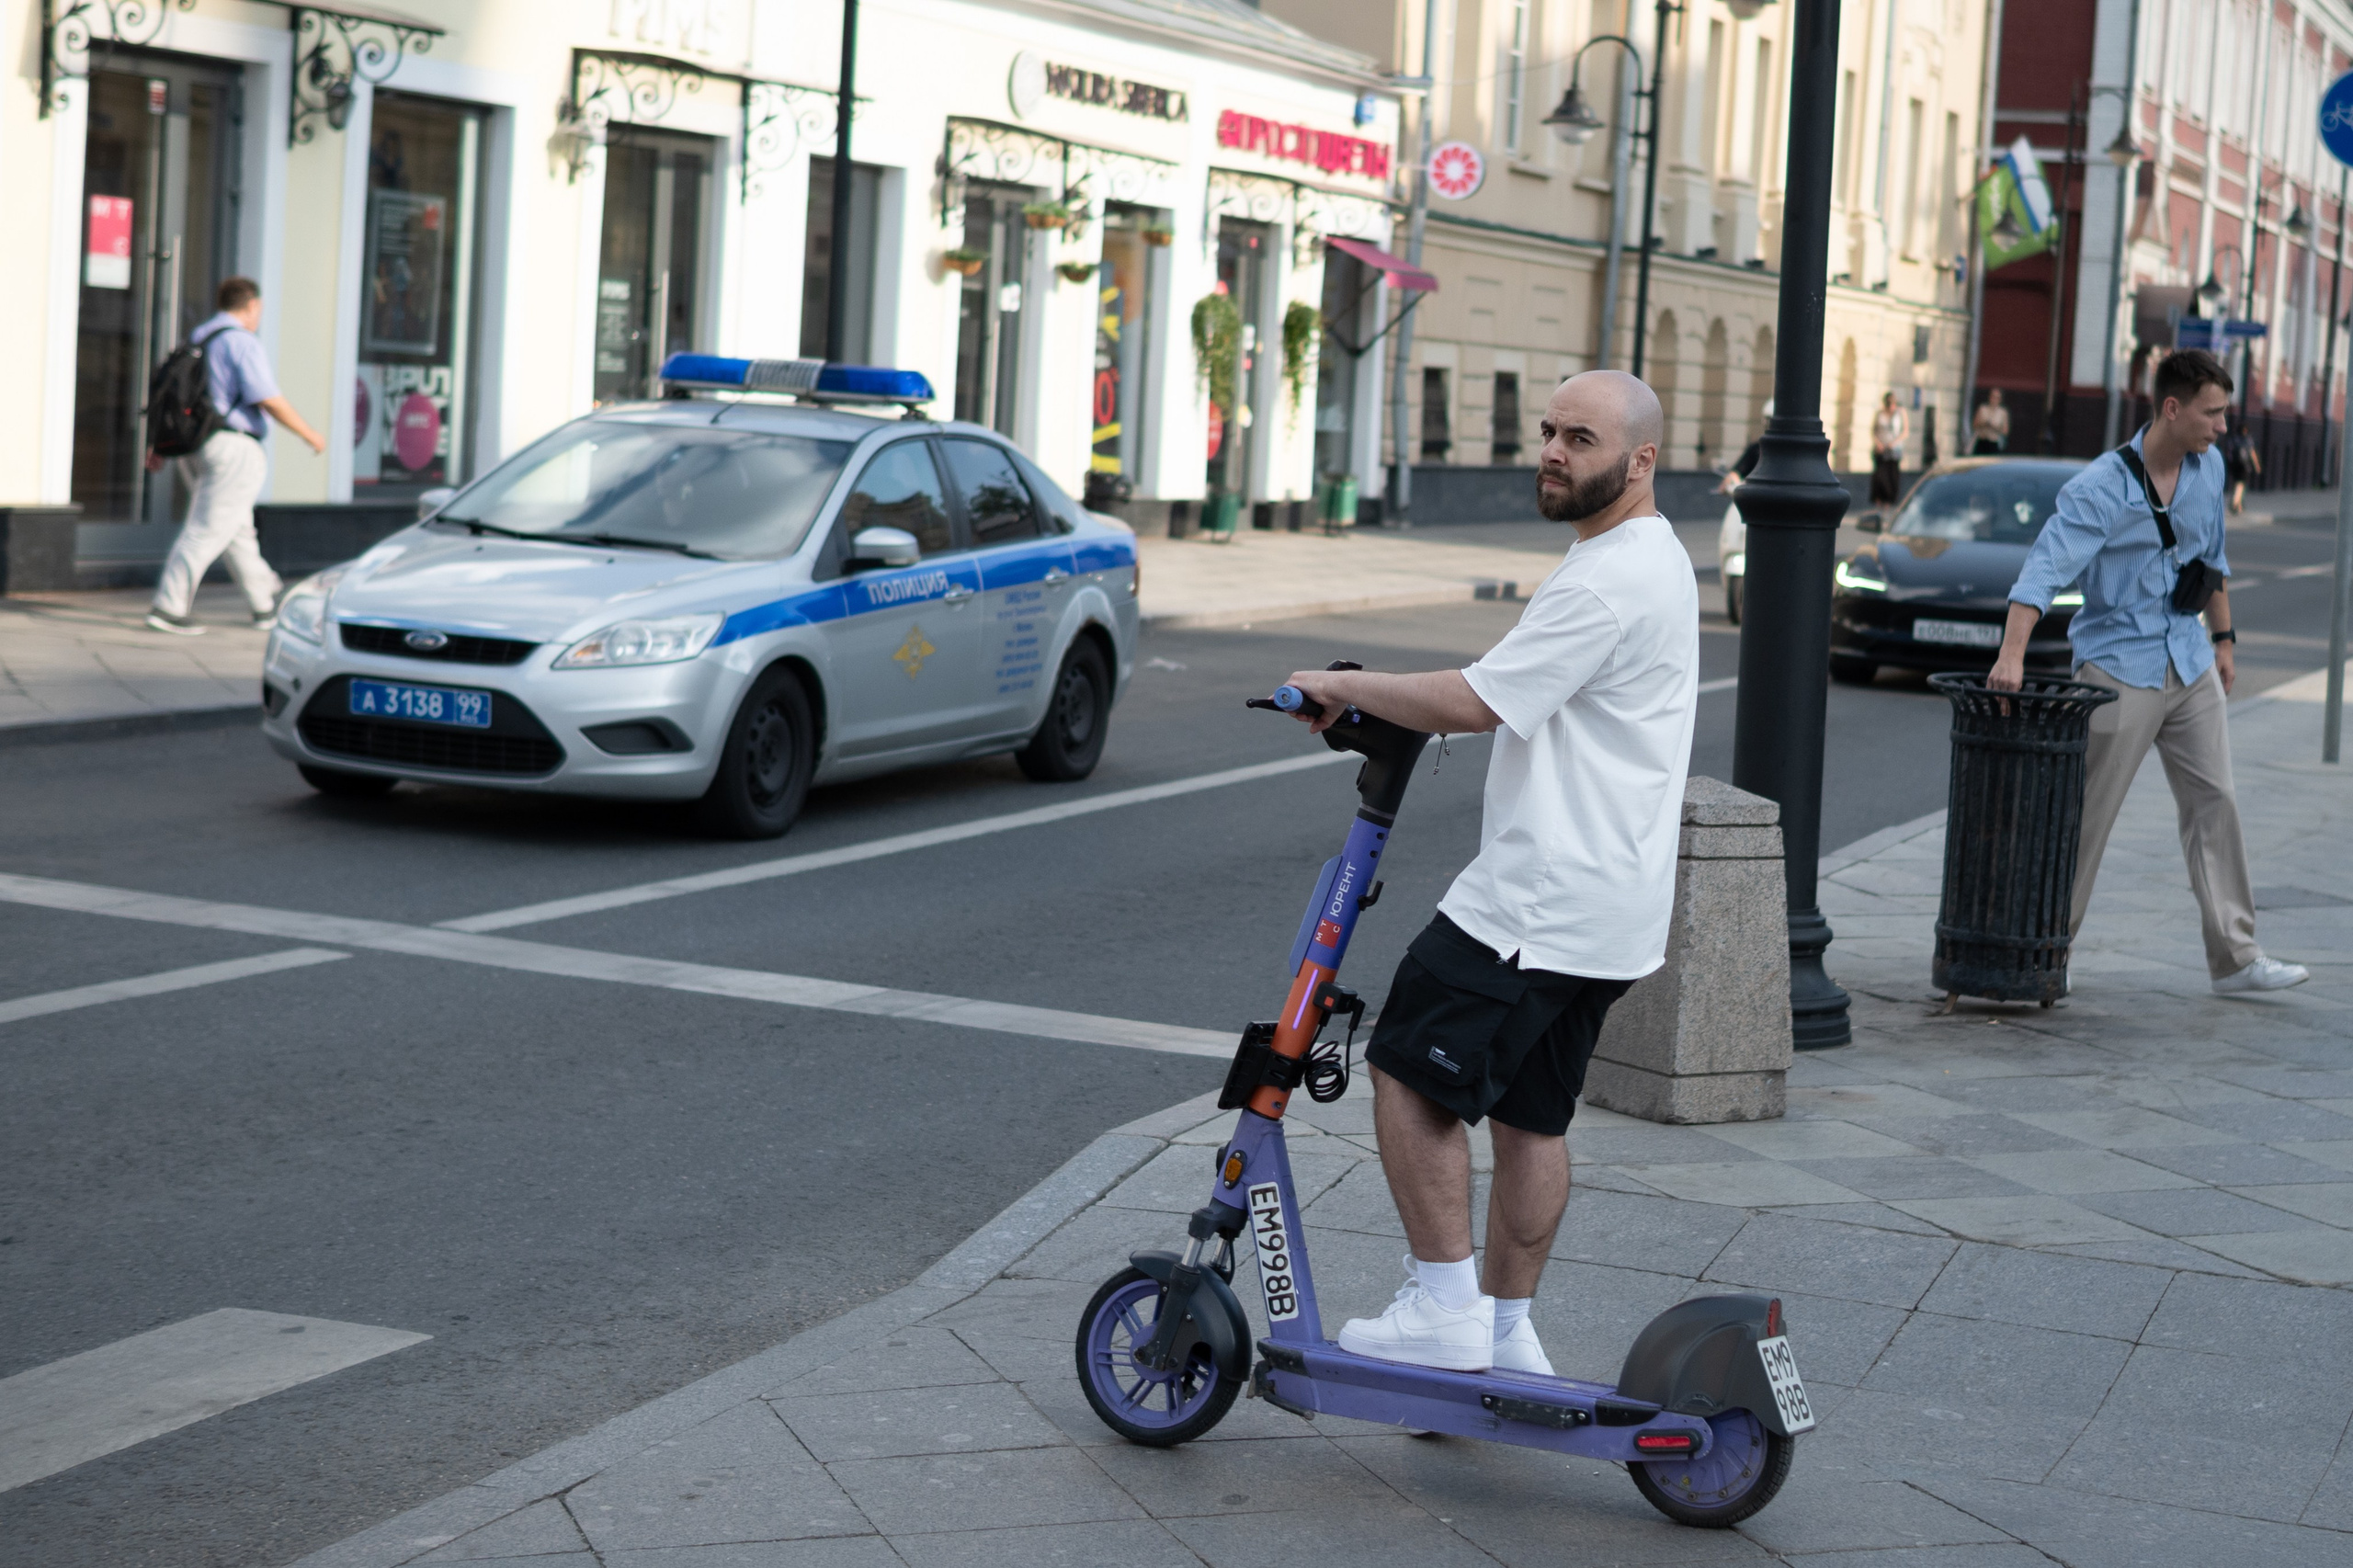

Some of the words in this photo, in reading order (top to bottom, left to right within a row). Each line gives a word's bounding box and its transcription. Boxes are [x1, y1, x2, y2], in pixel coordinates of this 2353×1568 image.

[868, 571, 949, 605] ПОЛИЦИЯ
[384, 687, 443, 719] 3138
[459, 693, 483, 716] 99
[1329, 861, 1357, 917] ЮРЕНТ
